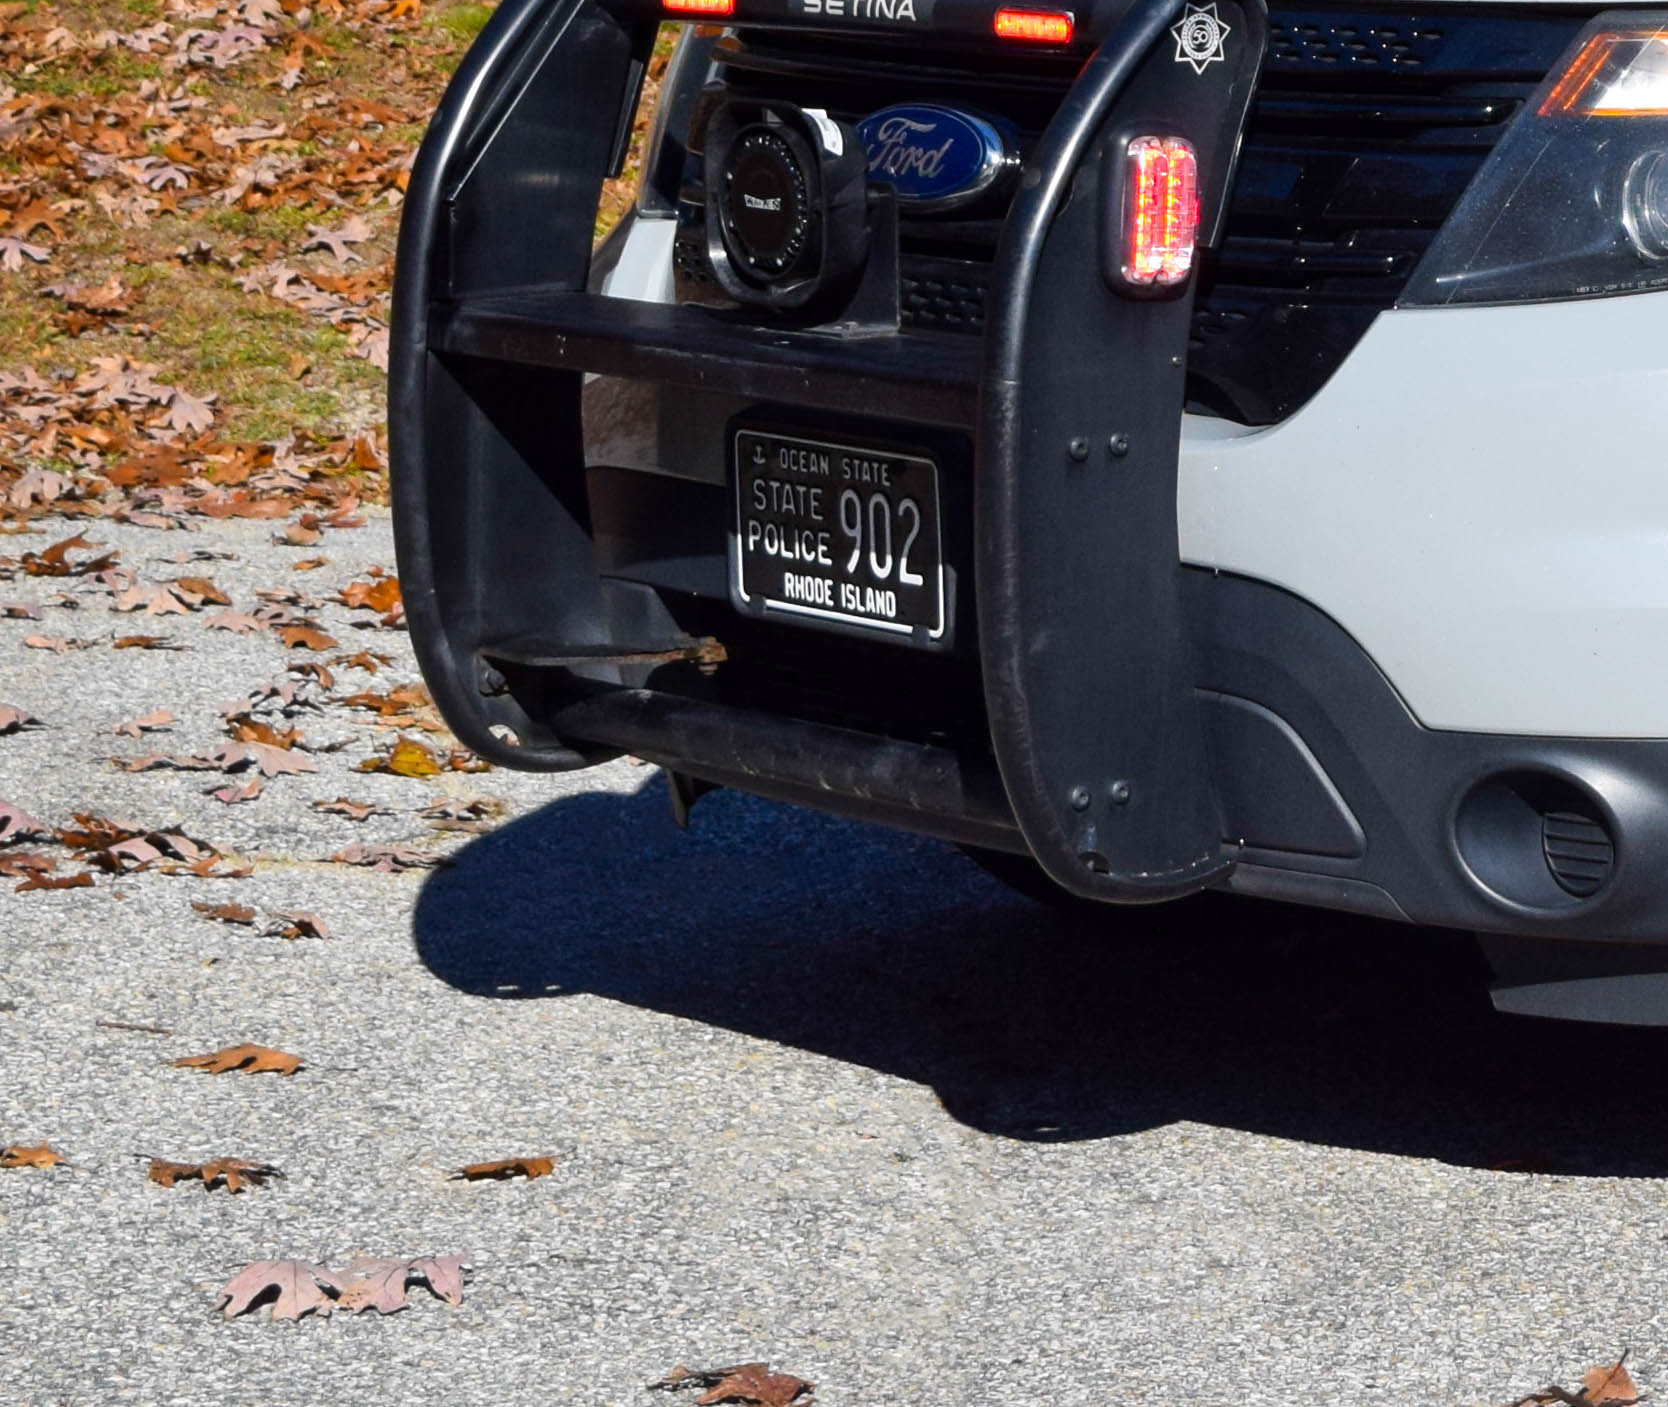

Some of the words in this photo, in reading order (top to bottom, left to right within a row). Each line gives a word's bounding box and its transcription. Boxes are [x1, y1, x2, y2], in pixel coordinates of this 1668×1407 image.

[867, 117, 953, 178] Ford
[779, 448, 830, 476] OCEAN
[842, 458, 891, 486] STATE
[752, 479, 824, 520] STATE
[748, 520, 833, 566] POLICE
[840, 489, 924, 586] 902
[784, 572, 835, 607] RHODE
[841, 583, 897, 618] ISLAND
